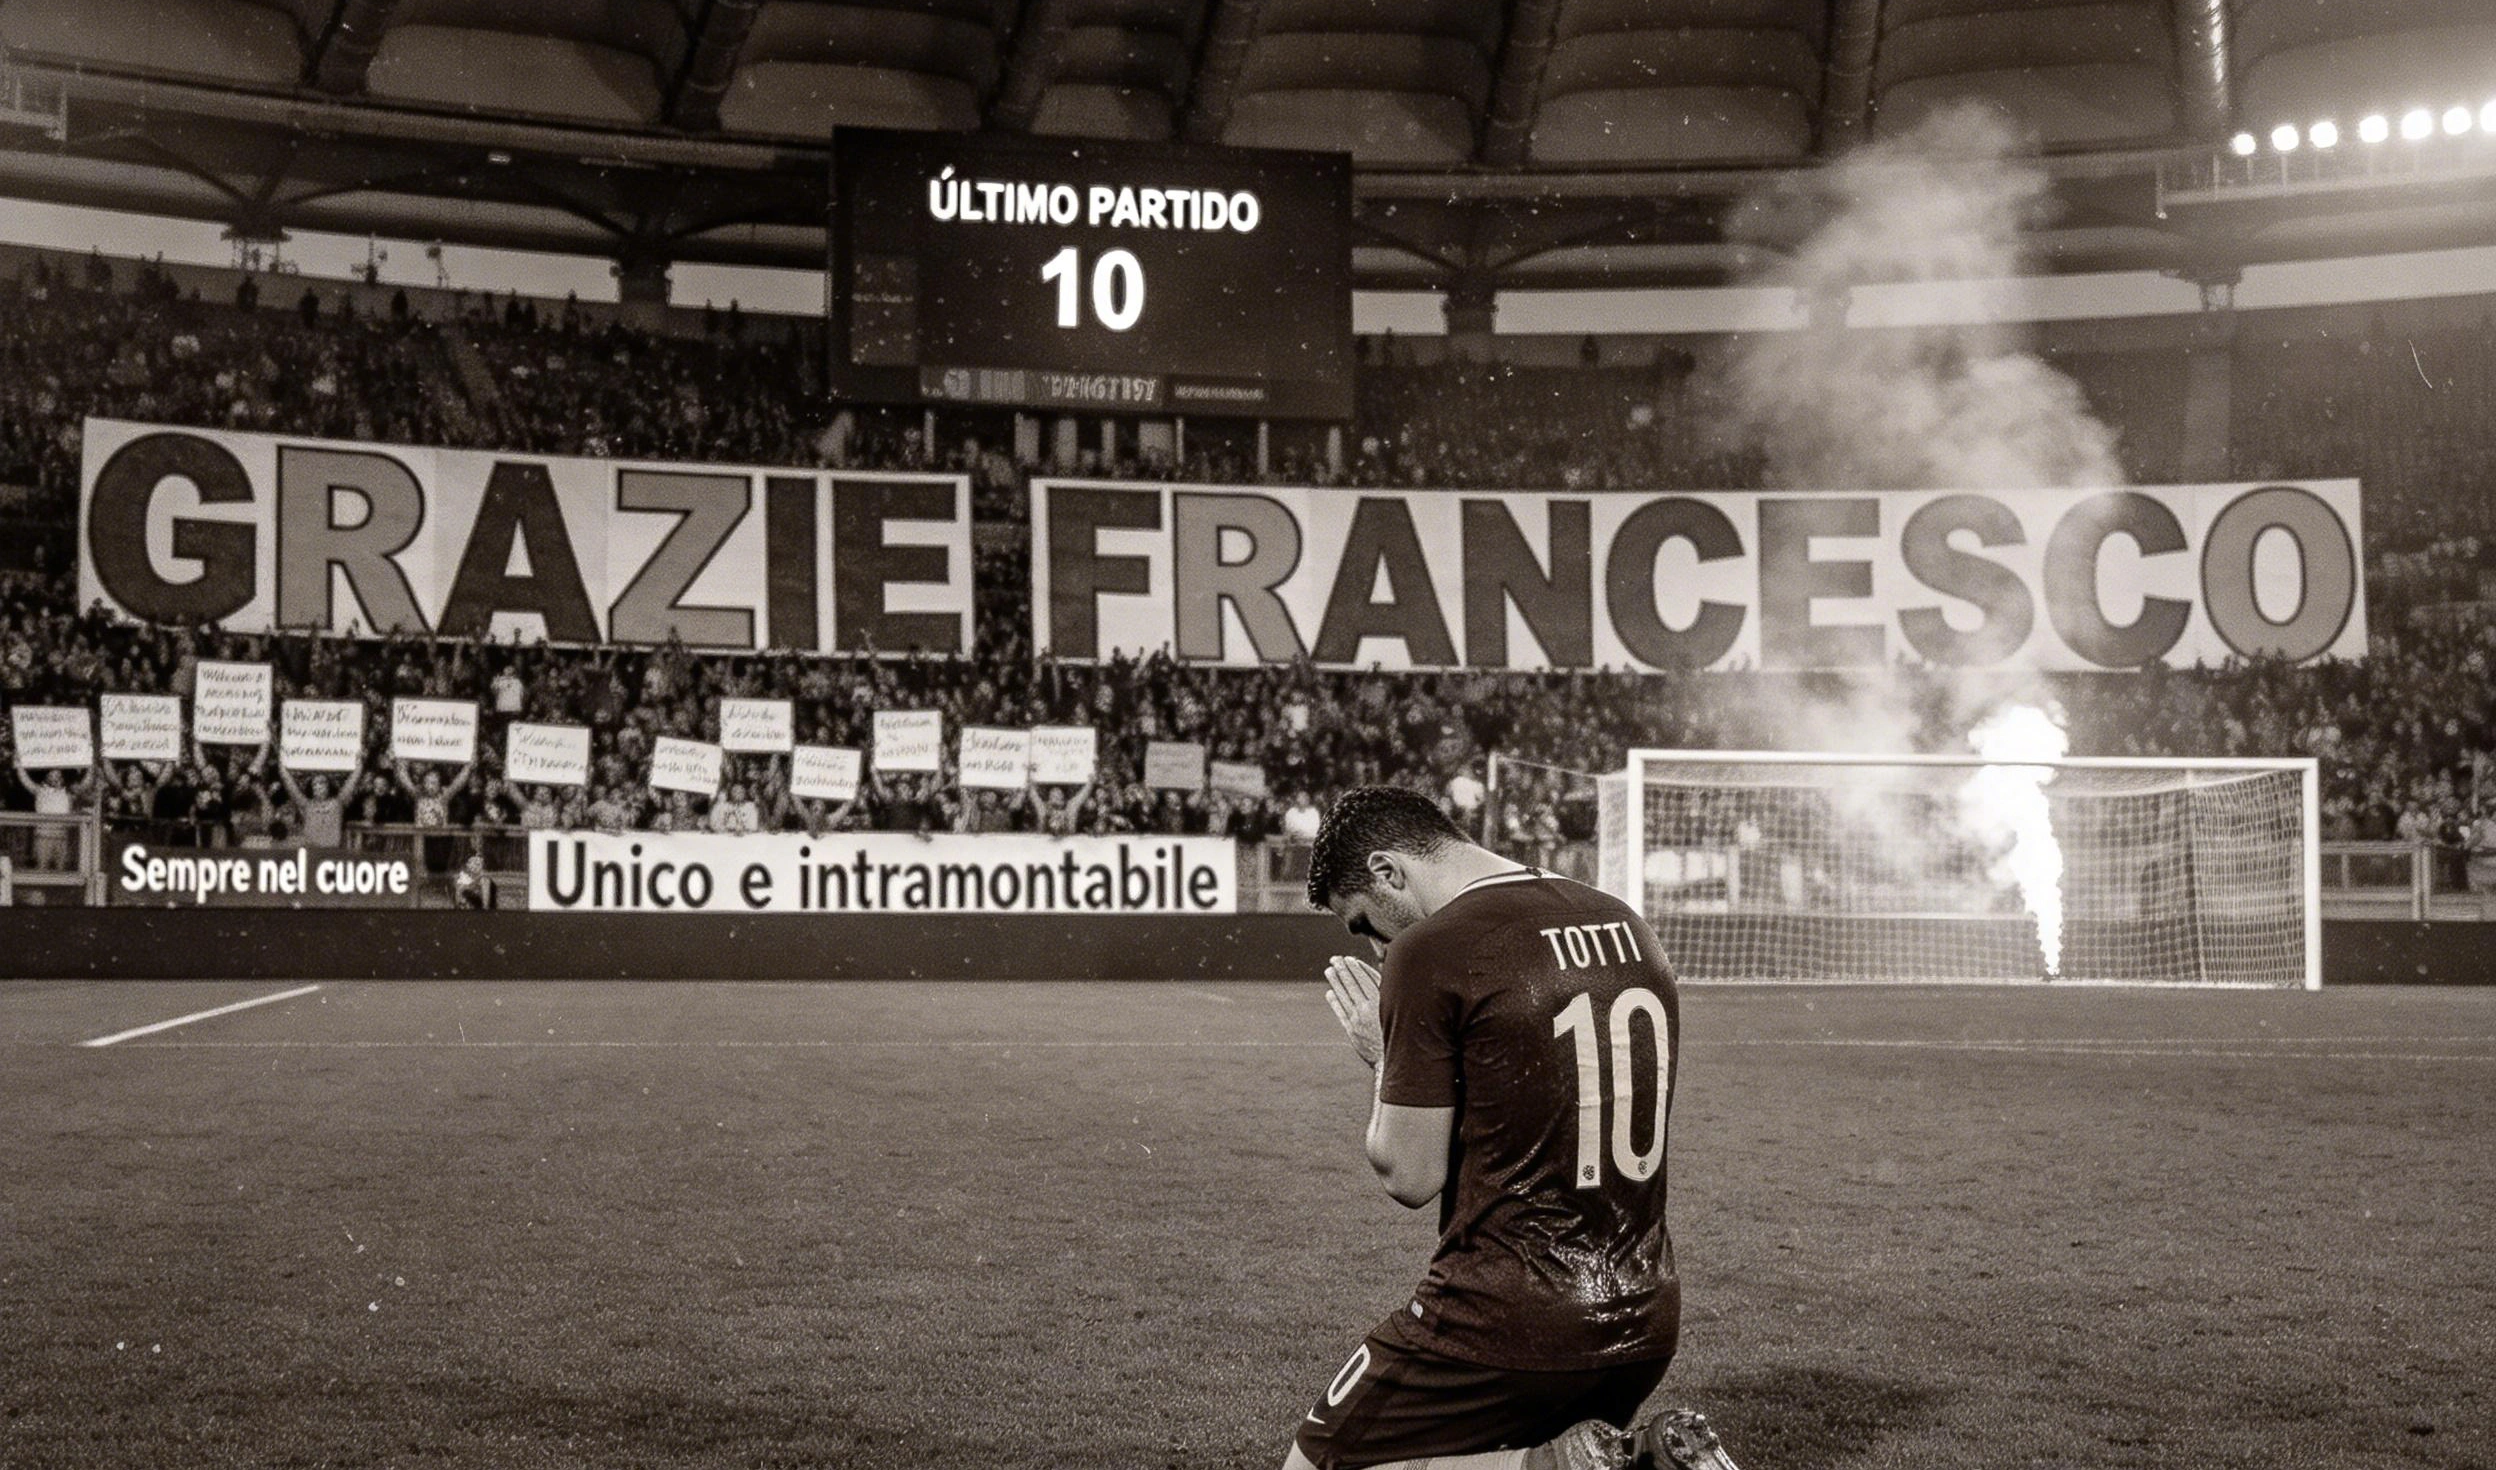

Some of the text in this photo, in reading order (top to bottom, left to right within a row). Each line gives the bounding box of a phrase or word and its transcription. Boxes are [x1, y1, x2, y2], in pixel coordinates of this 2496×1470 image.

[928, 165, 1261, 234] ÚLTIMO PARTIDO
[1041, 246, 1146, 332] 10
[86, 430, 2356, 672] GRAZIE FRANCESCO
[121, 843, 409, 903] Sempre nel cuore
[546, 840, 1219, 910] Unico e intramontabile
[1540, 921, 1642, 971] TOTTI
[1553, 988, 1670, 1190] 10
